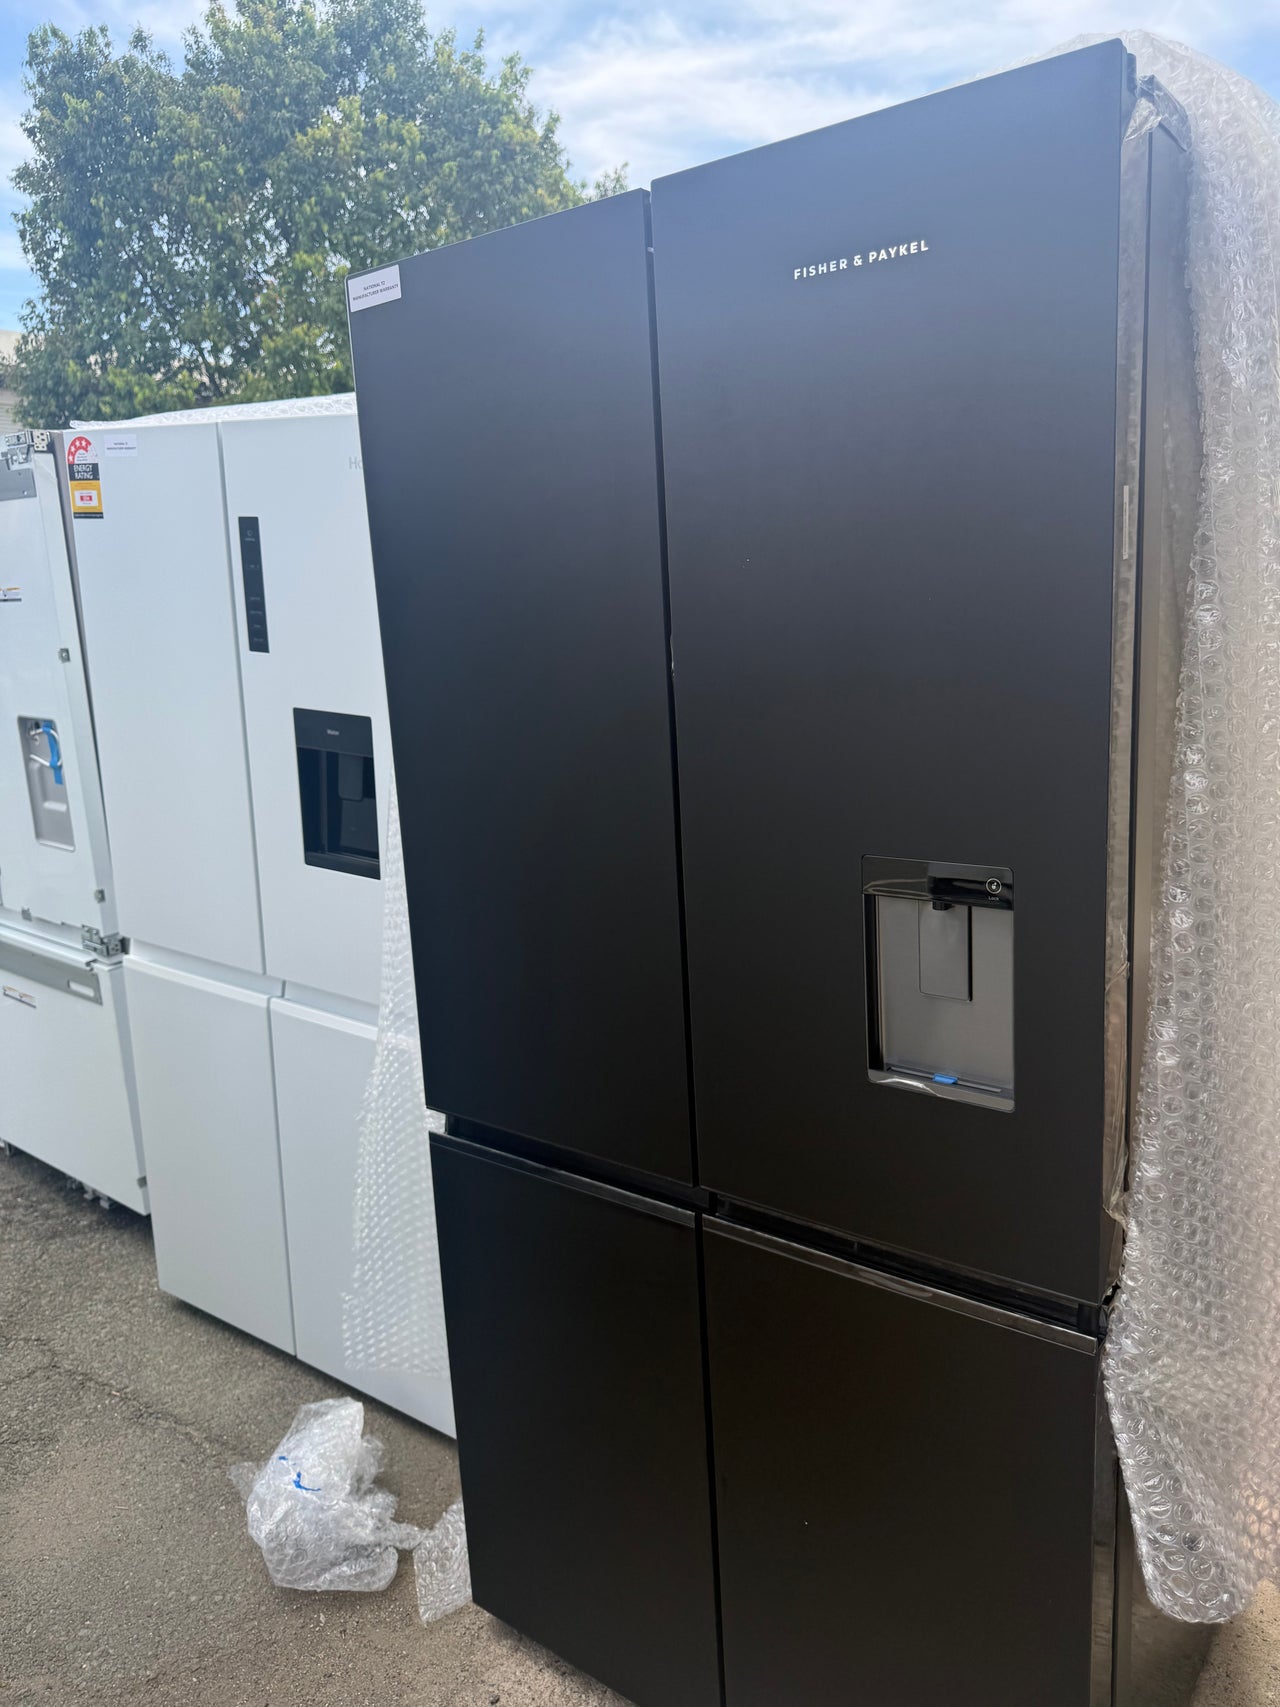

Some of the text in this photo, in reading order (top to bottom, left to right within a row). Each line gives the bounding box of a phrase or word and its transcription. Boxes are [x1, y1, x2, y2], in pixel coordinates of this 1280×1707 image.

[794, 240, 929, 280] FISHER & PAYKEL
[73, 464, 93, 472] ENERGY
